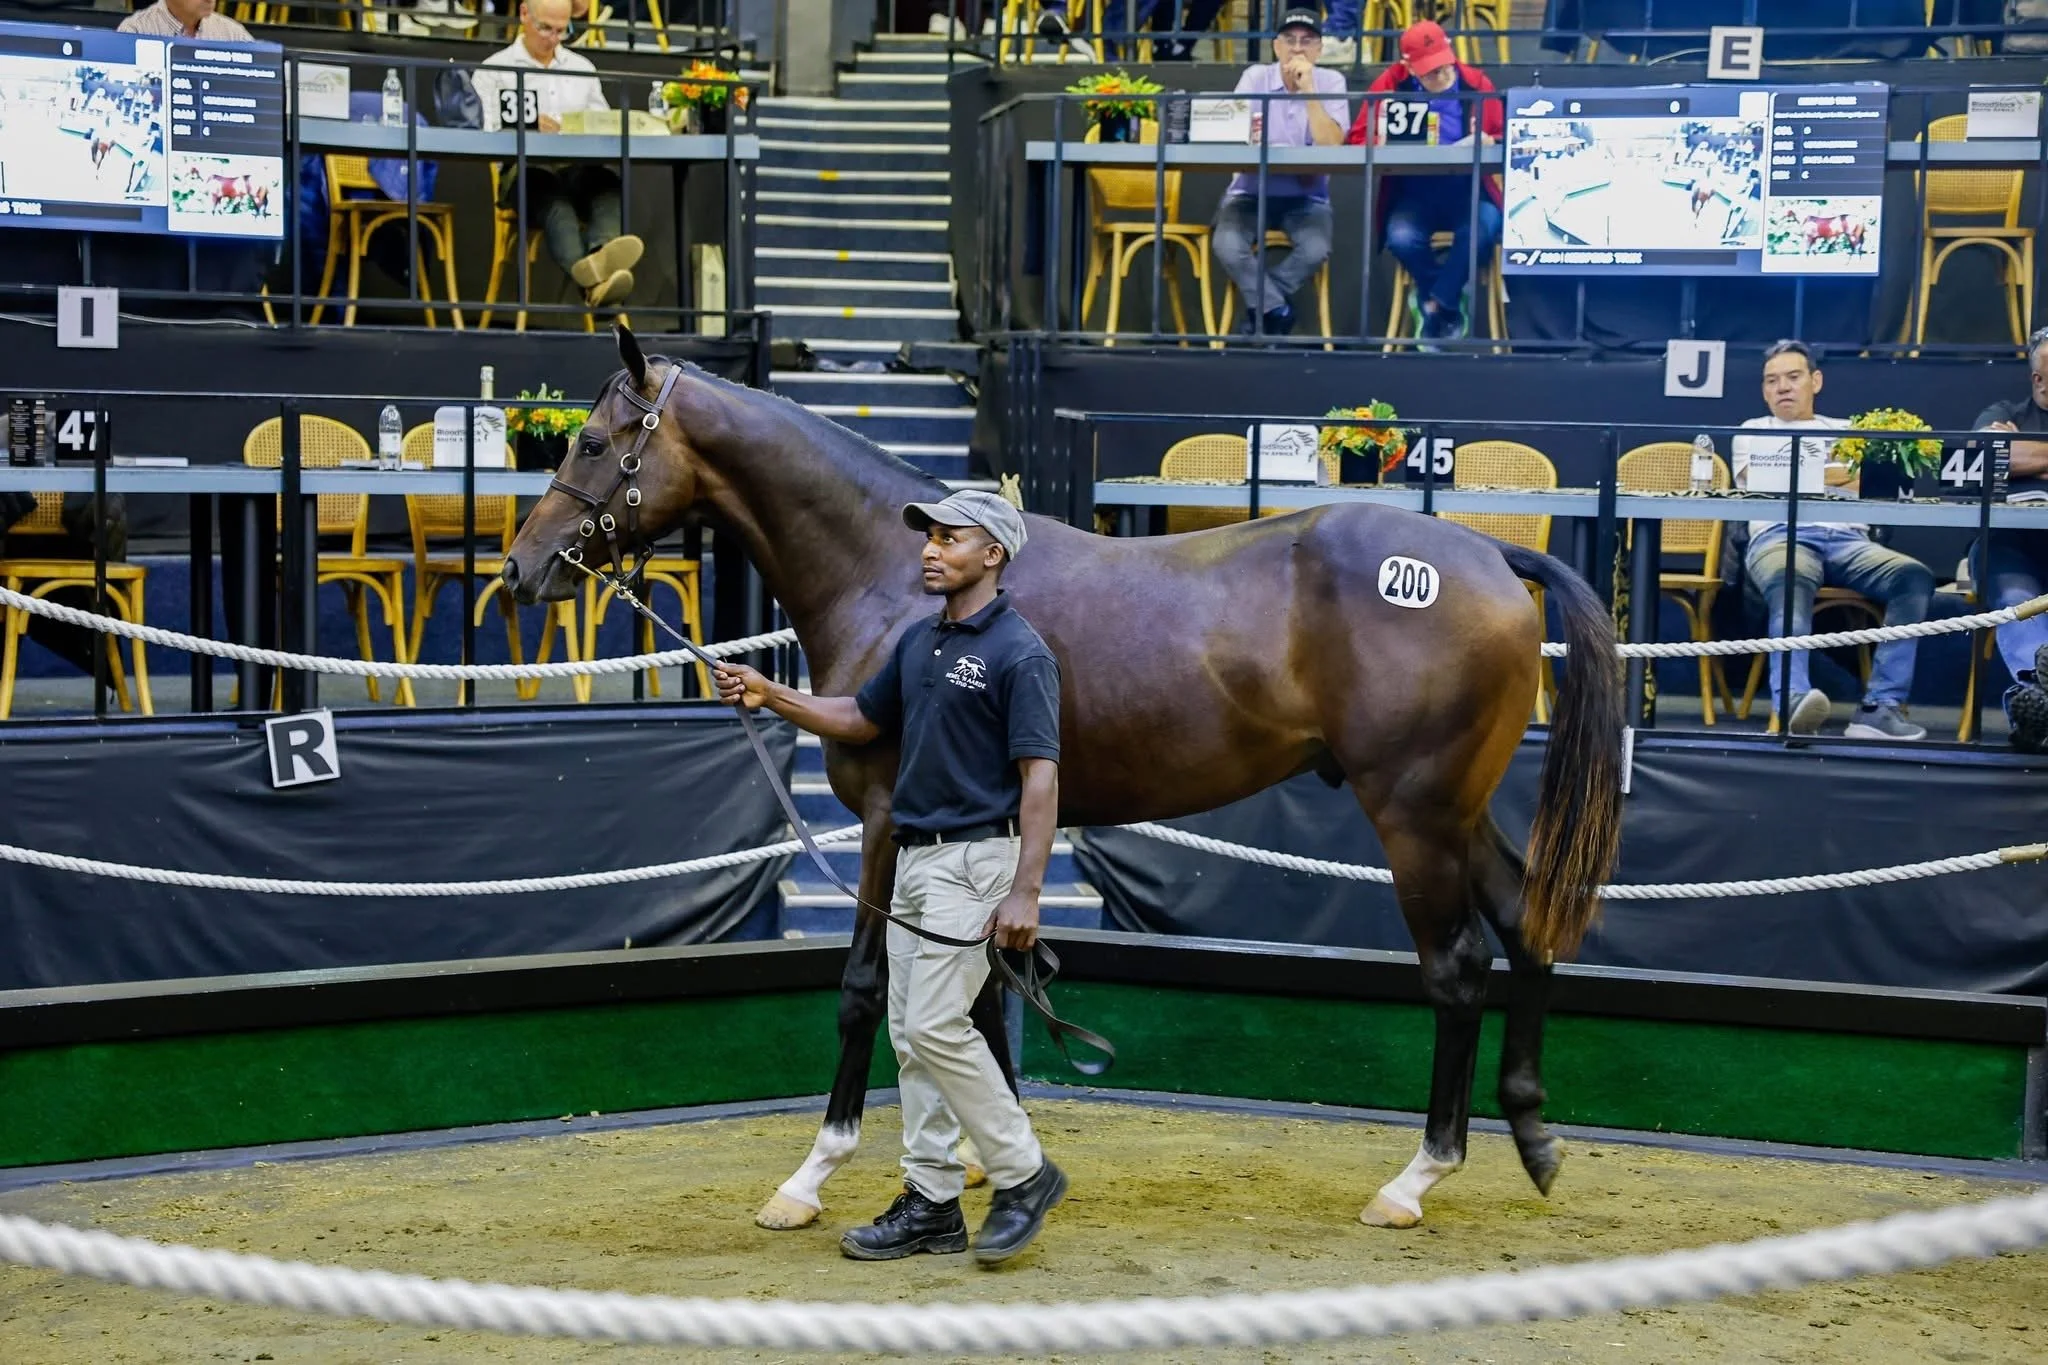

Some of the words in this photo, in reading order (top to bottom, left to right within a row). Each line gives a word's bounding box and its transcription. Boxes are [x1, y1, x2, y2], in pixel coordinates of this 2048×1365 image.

[1720, 36, 1752, 70] E
[1388, 102, 1429, 135] 37
[80, 297, 94, 338] I
[1678, 351, 1711, 389] J
[58, 410, 108, 451] 47
[1407, 436, 1454, 474] 45
[1941, 448, 1984, 488] 44
[1384, 560, 1430, 602] 200
[270, 718, 335, 782] R
